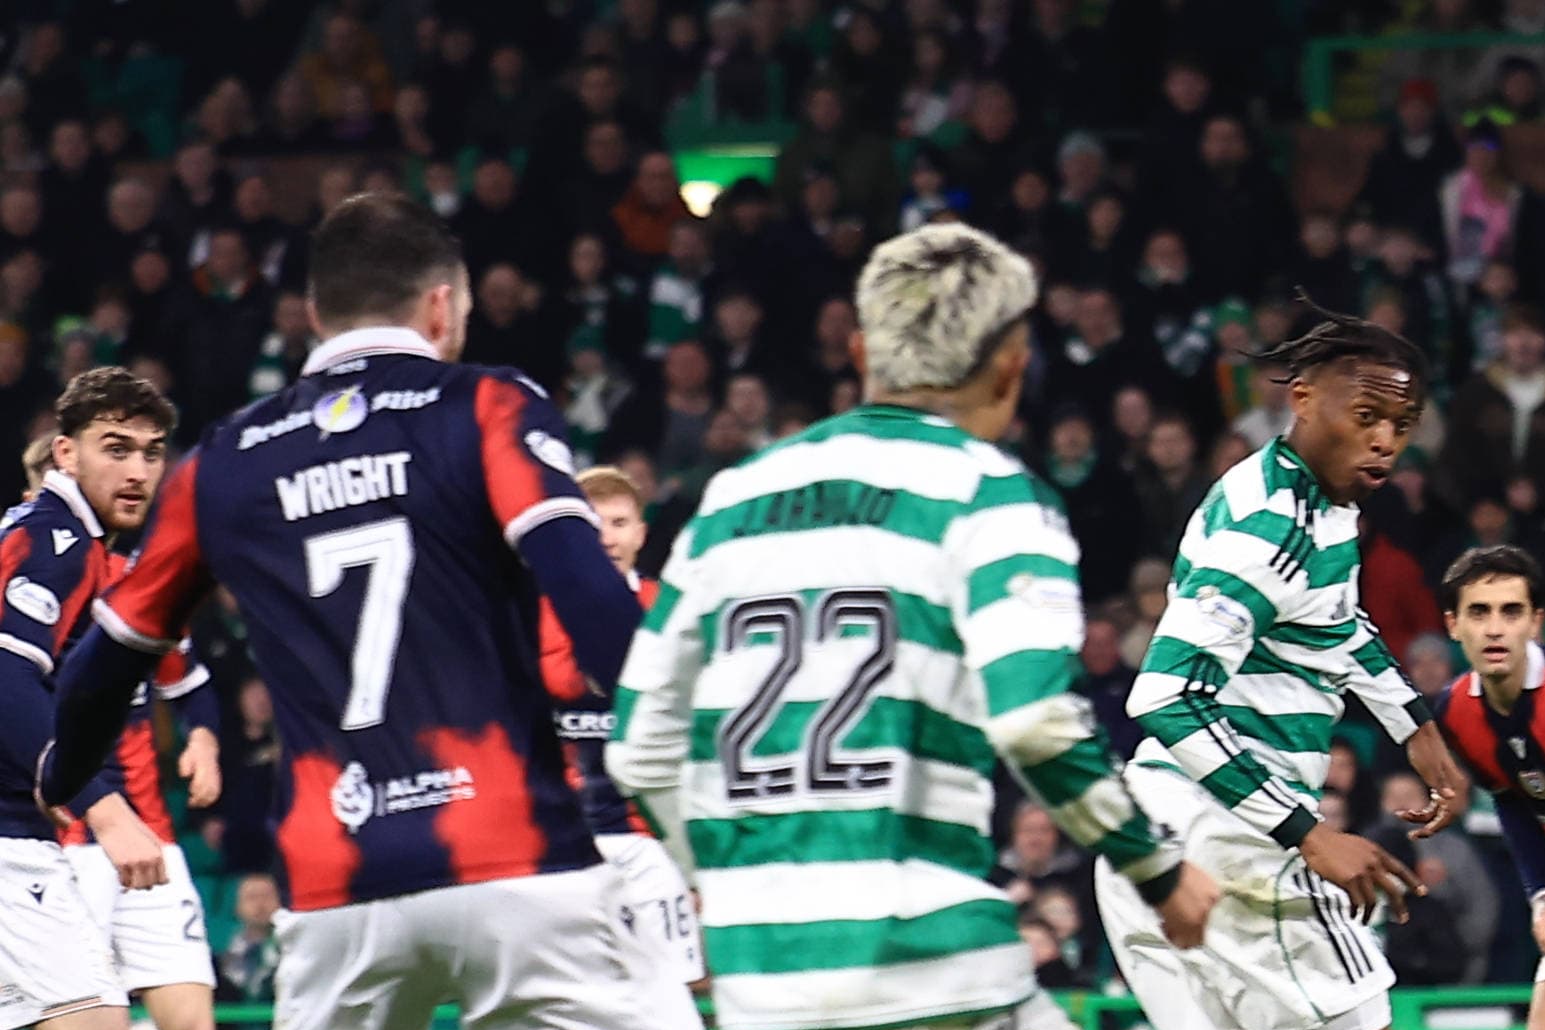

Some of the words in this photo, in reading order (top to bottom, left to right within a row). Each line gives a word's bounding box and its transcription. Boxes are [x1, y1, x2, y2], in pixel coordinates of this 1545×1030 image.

[275, 451, 412, 521] WRIGHT
[304, 515, 415, 731] 7
[717, 586, 897, 800] 22
[387, 766, 474, 799] ALPHA
